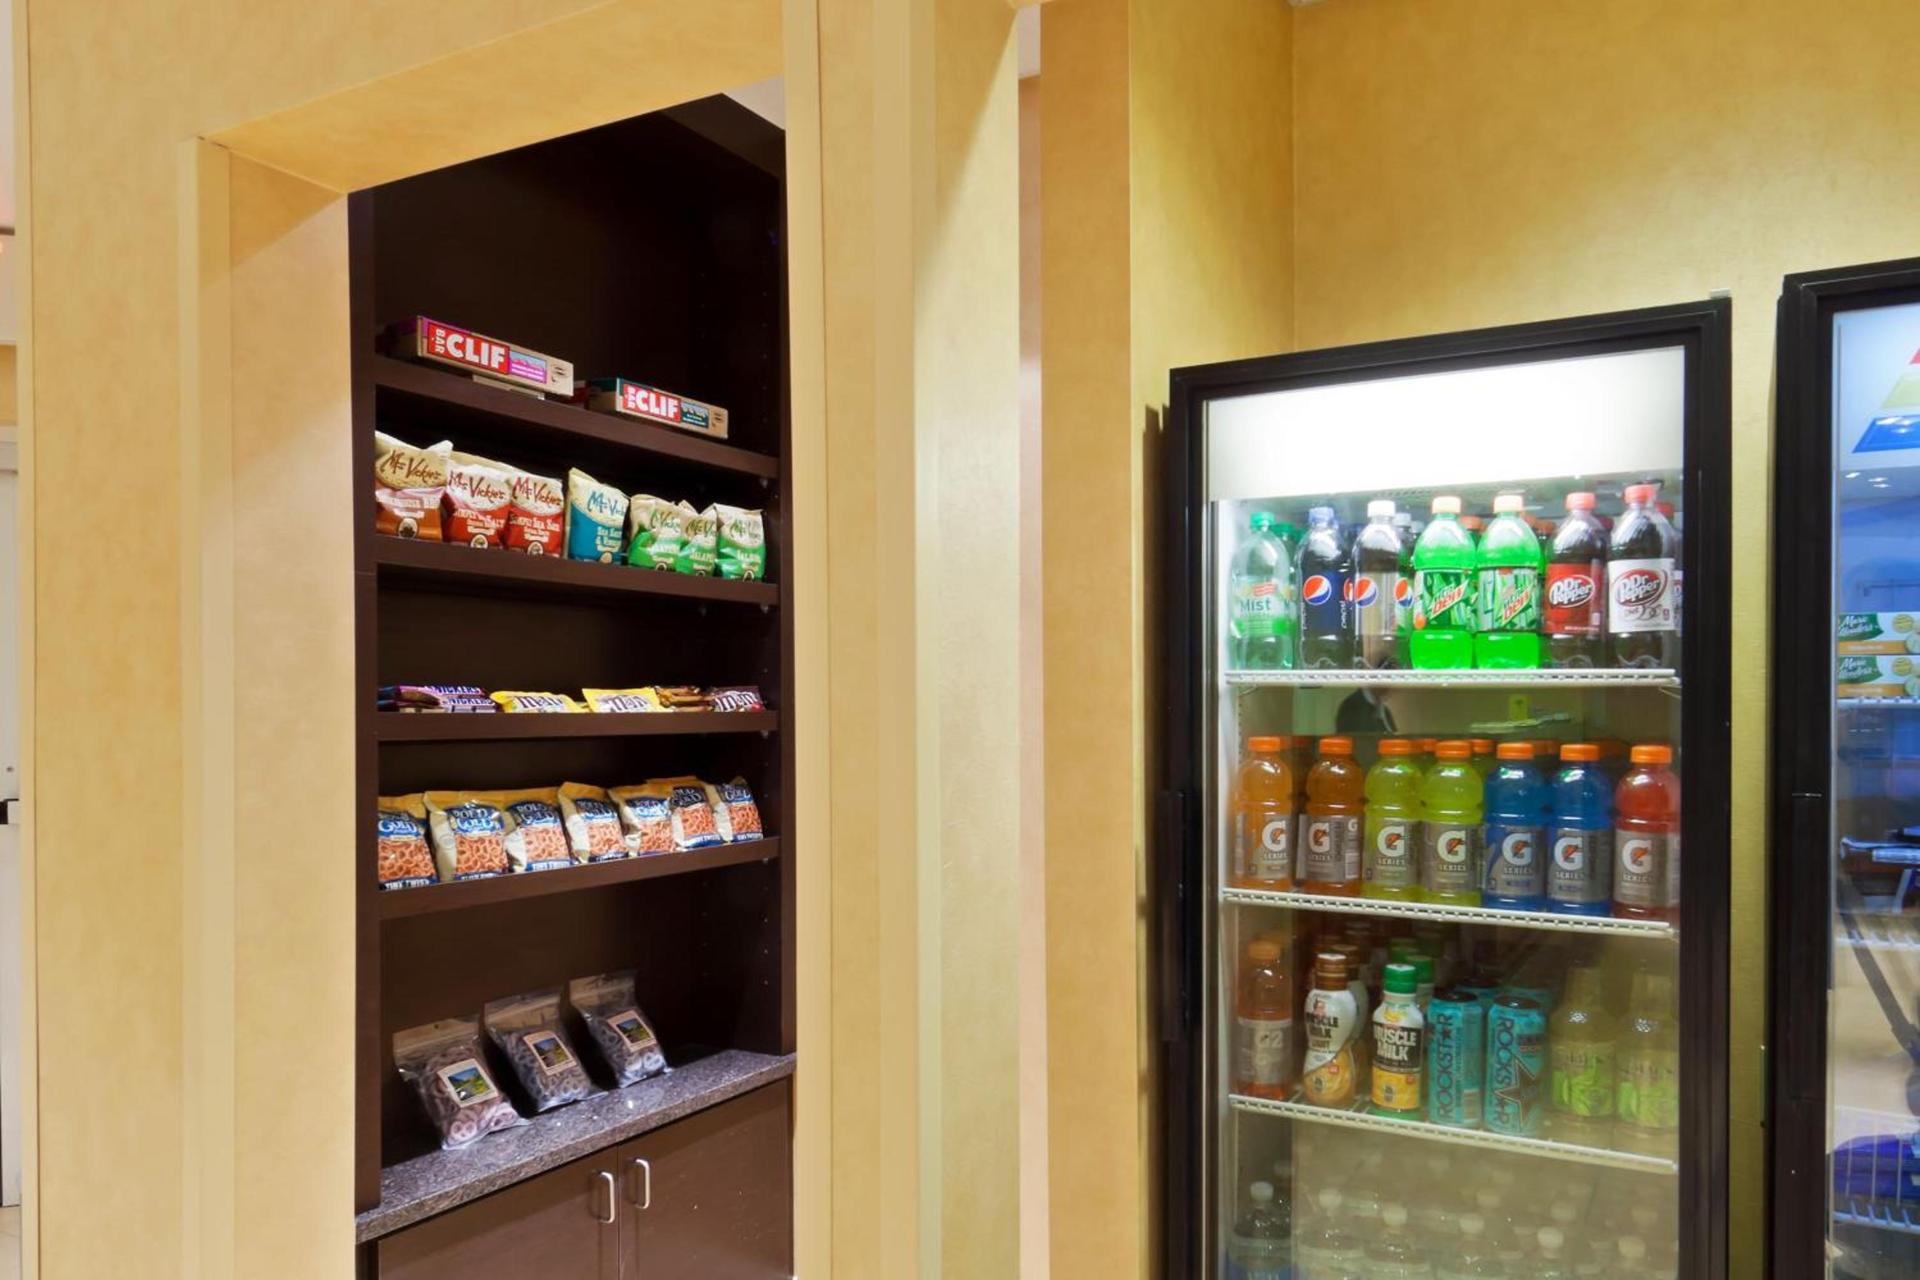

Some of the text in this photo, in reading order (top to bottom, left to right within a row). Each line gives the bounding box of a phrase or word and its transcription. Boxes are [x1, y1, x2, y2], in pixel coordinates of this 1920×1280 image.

[434, 328, 446, 354] BAR
[446, 333, 506, 369] CLIF
[635, 388, 679, 418] CLIF
[1551, 581, 1592, 605] Pepper
[1564, 577, 1581, 589] Dr
[1620, 580, 1660, 602] Pepper
[1631, 574, 1649, 587] Dr
[1240, 597, 1271, 612] Mist
[1262, 820, 1287, 852] G
[1309, 822, 1330, 853] G
[1377, 826, 1405, 857] G
[1437, 831, 1467, 863] G
[1502, 832, 1532, 866] G
[1554, 837, 1583, 871] G
[1622, 839, 1652, 873] G
[1373, 1023, 1417, 1047] MUSCLE
[1376, 1039, 1409, 1061] MILK
